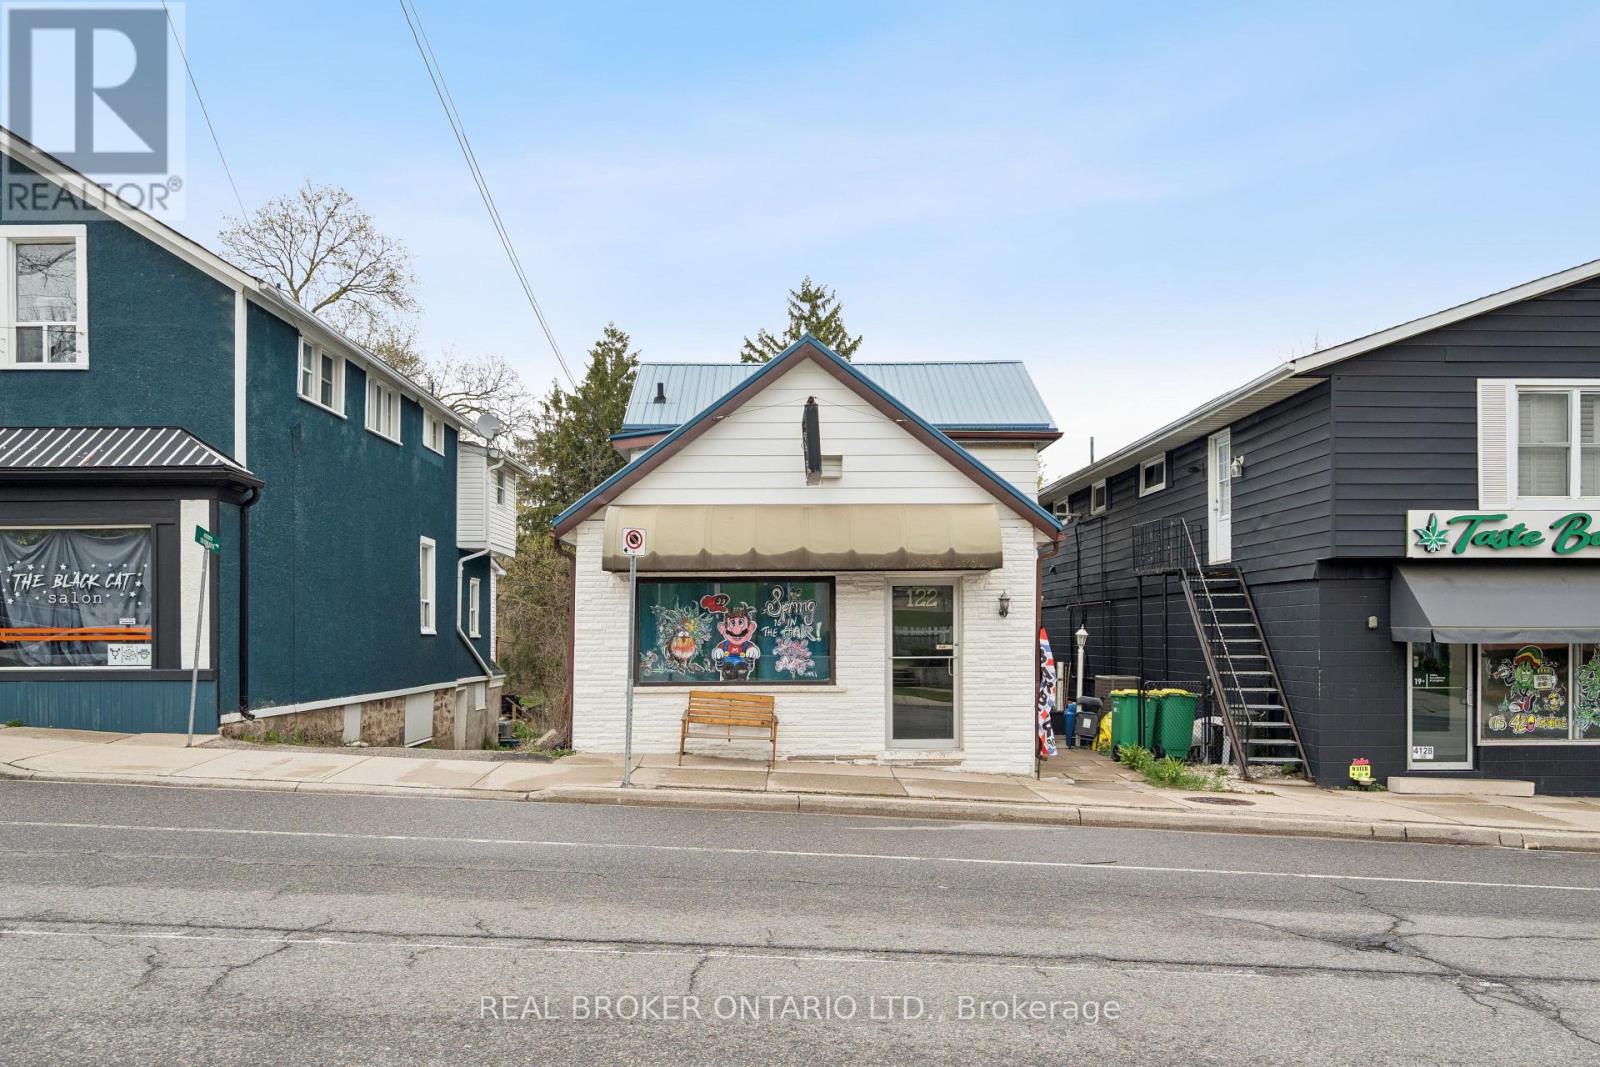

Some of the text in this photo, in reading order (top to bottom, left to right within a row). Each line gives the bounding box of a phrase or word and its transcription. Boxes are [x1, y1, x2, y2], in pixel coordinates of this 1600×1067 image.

[1447, 513, 1546, 555] Taste
[12, 571, 136, 592] THE BLACK CAT
[48, 592, 102, 604] salon
[762, 585, 817, 626] Spring
[907, 588, 938, 608] 122
[761, 626, 777, 637] THE
[1413, 747, 1433, 755] 4128
